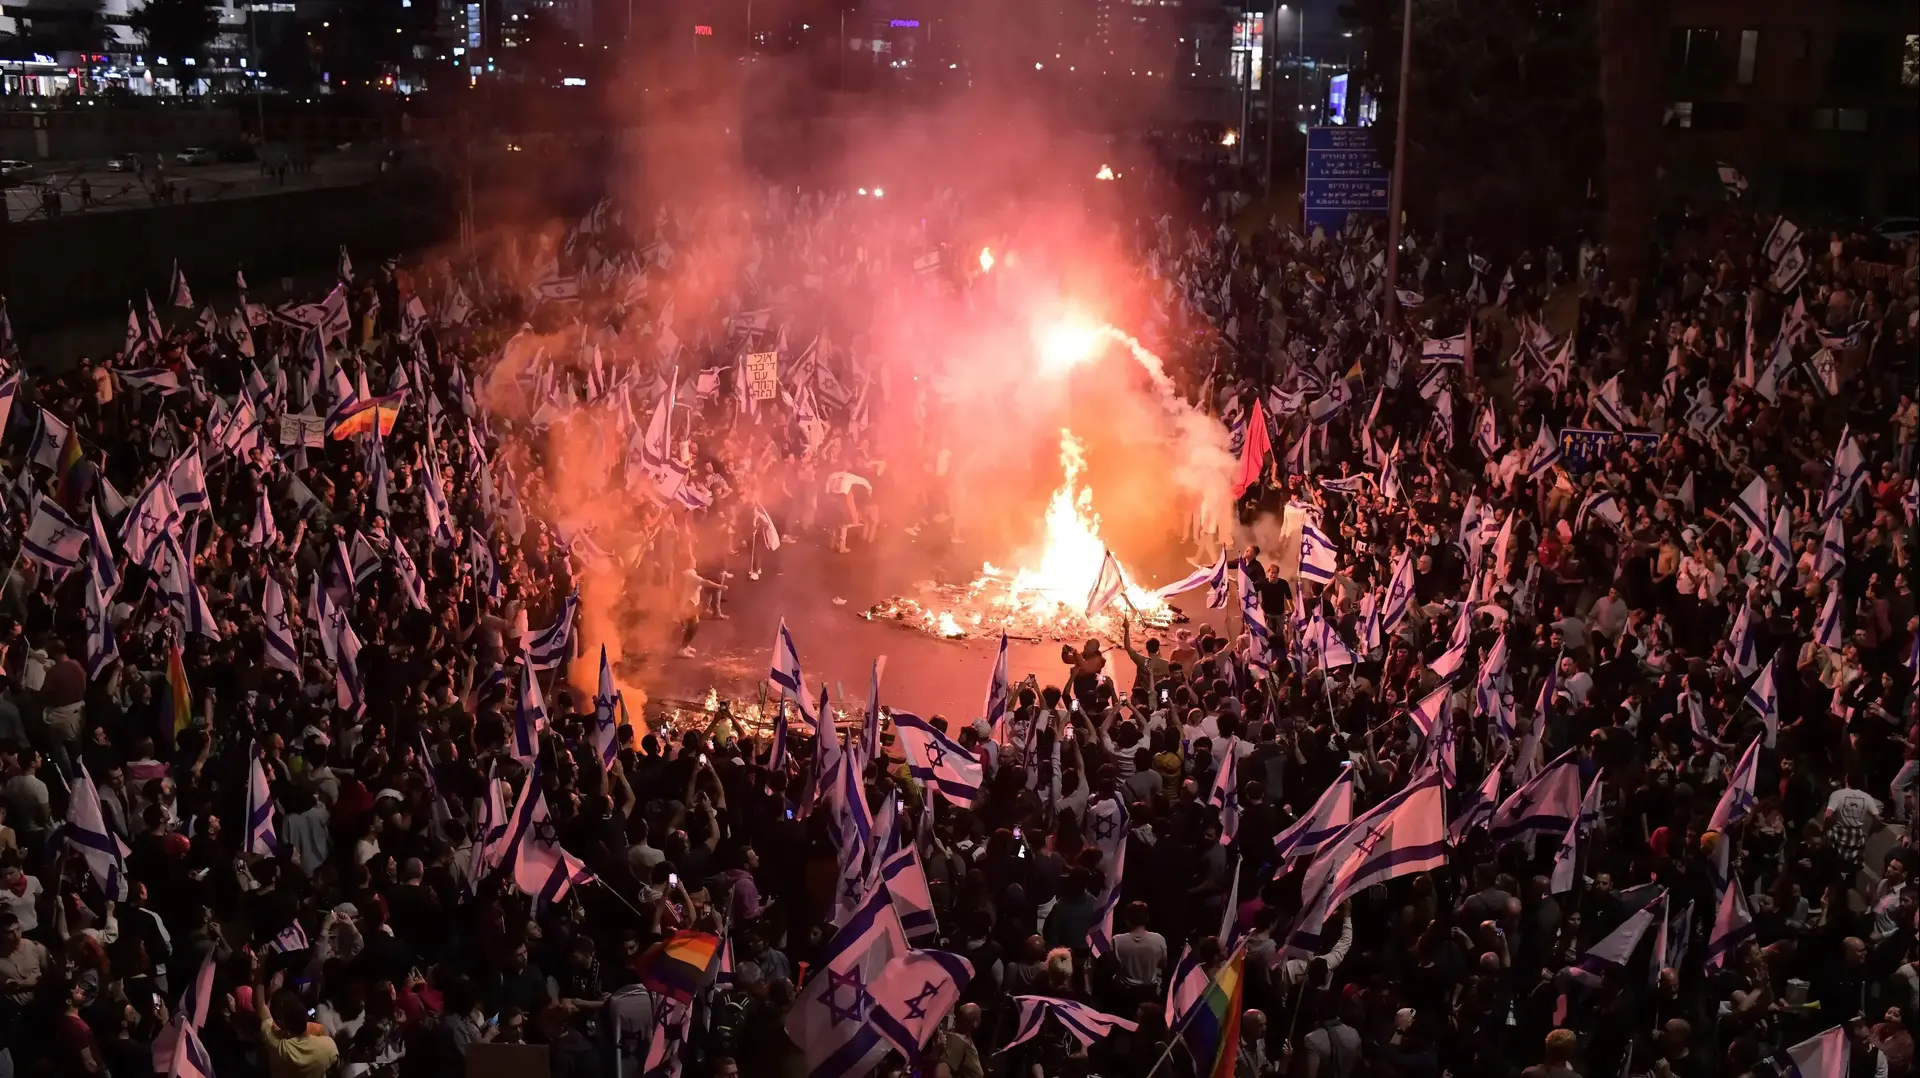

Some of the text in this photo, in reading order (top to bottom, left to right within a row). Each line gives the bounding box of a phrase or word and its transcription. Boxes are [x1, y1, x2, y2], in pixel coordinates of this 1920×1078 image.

[753, 353, 772, 363] אולי
[747, 362, 775, 371] די כבר
[754, 371, 768, 380] עם
[752, 380, 774, 389] החר
